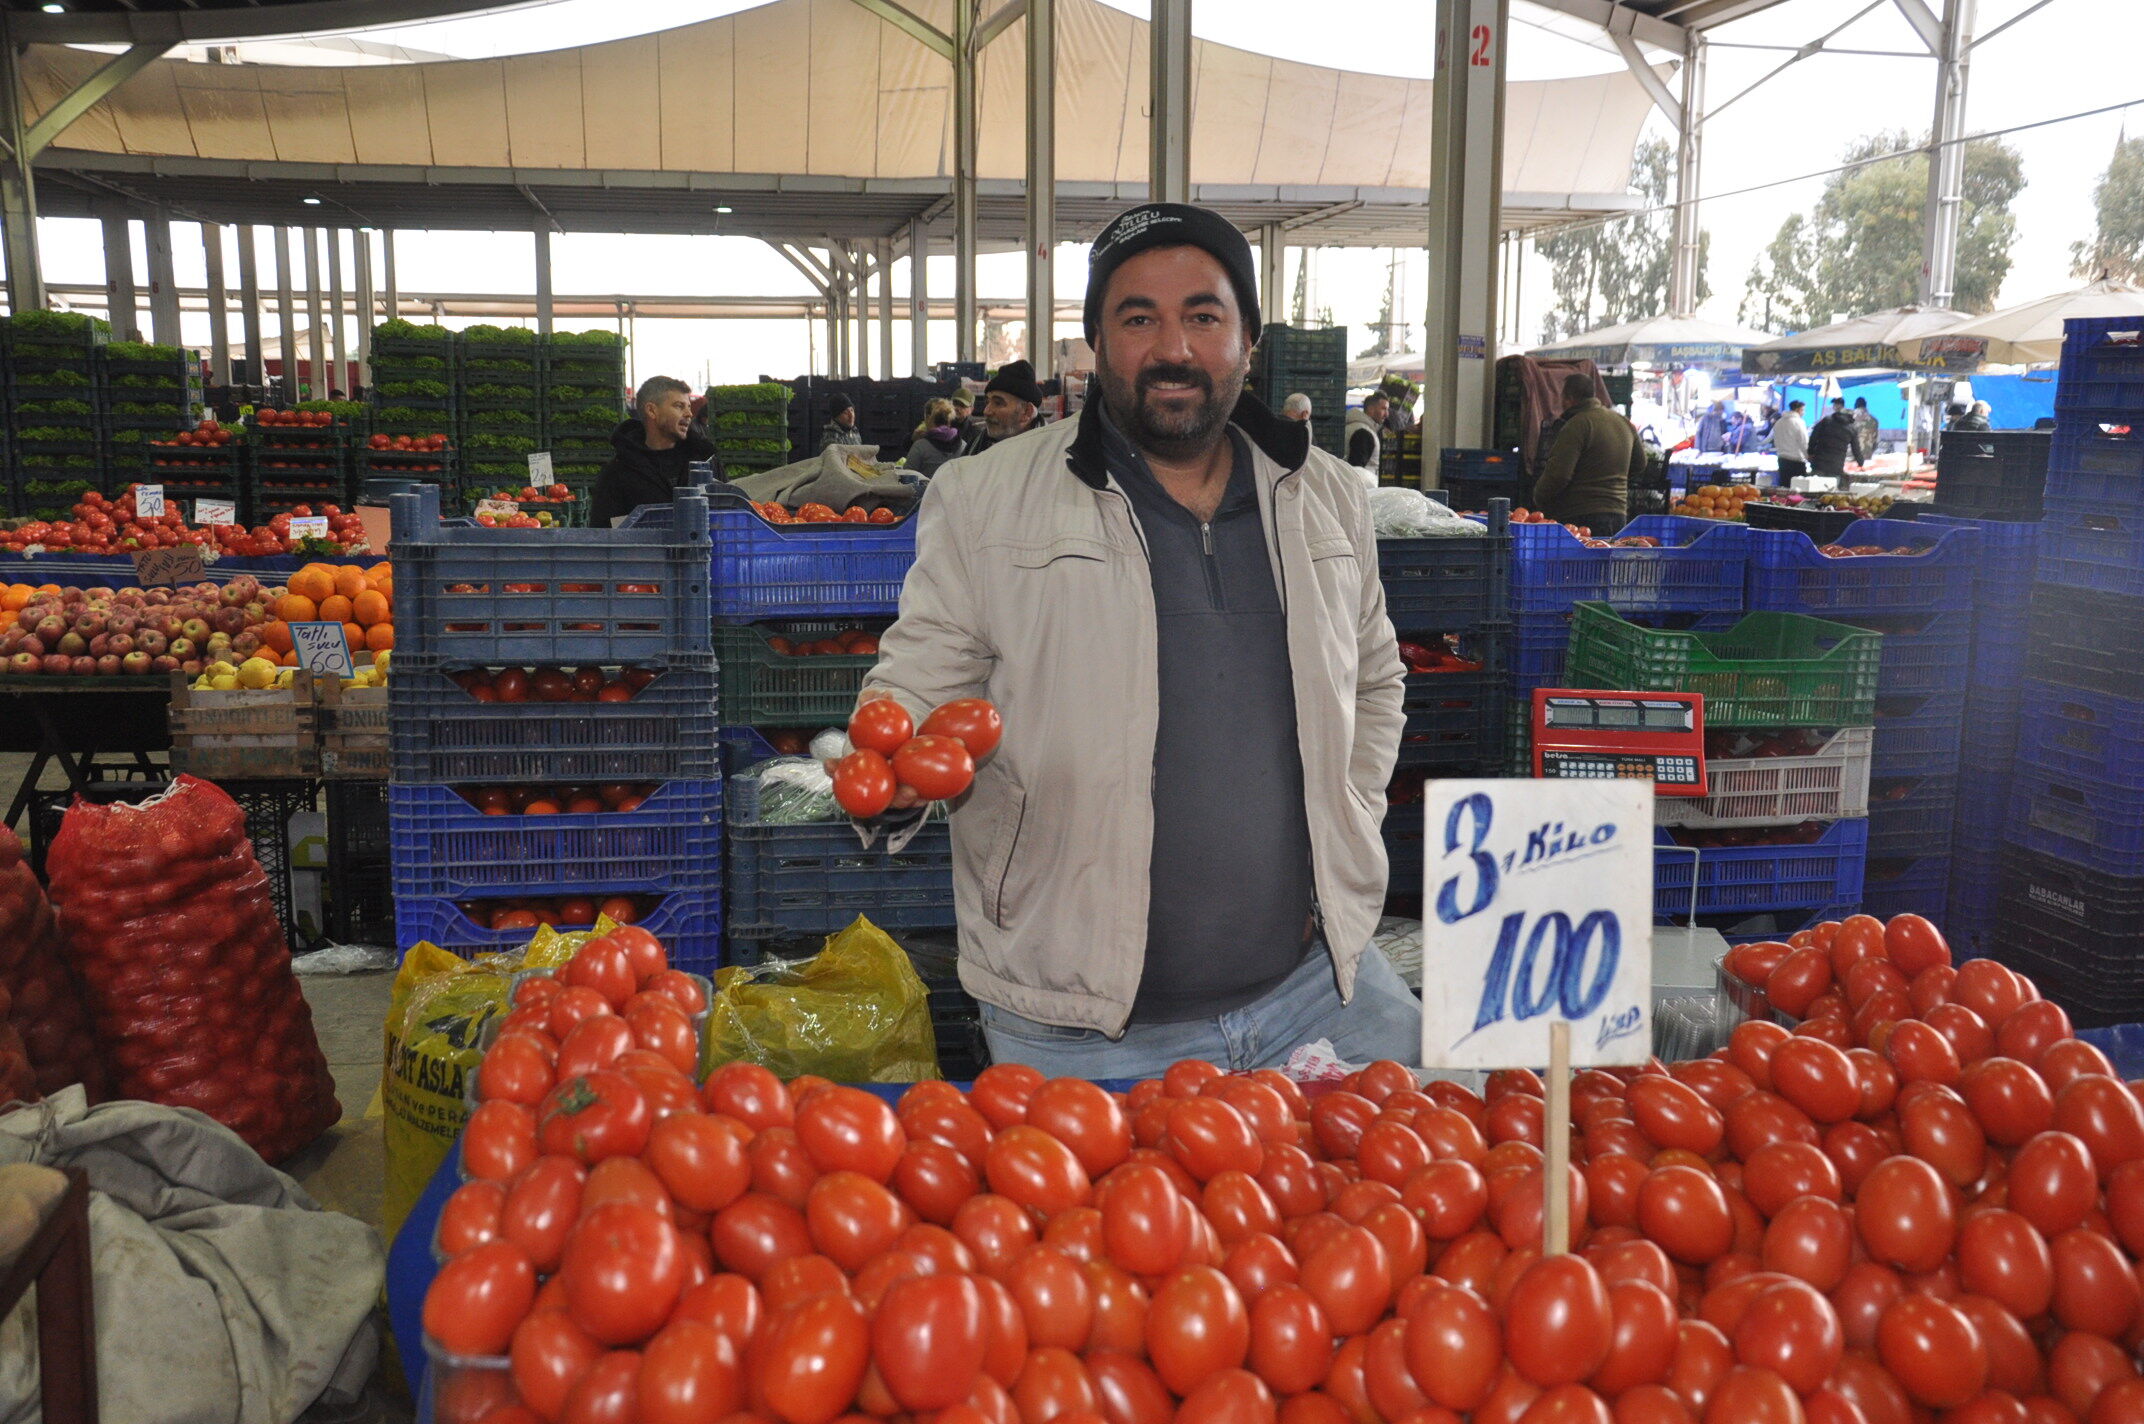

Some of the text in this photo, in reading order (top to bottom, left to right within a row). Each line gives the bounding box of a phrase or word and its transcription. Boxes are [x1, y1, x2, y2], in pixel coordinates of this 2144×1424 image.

[1471, 24, 1491, 67] 2
[1037, 242, 1047, 260] 4
[1810, 349, 1837, 366] AS
[310, 650, 345, 673] 60
[2029, 883, 2085, 912] BABACANLAR
[1451, 909, 1622, 1050] 100
